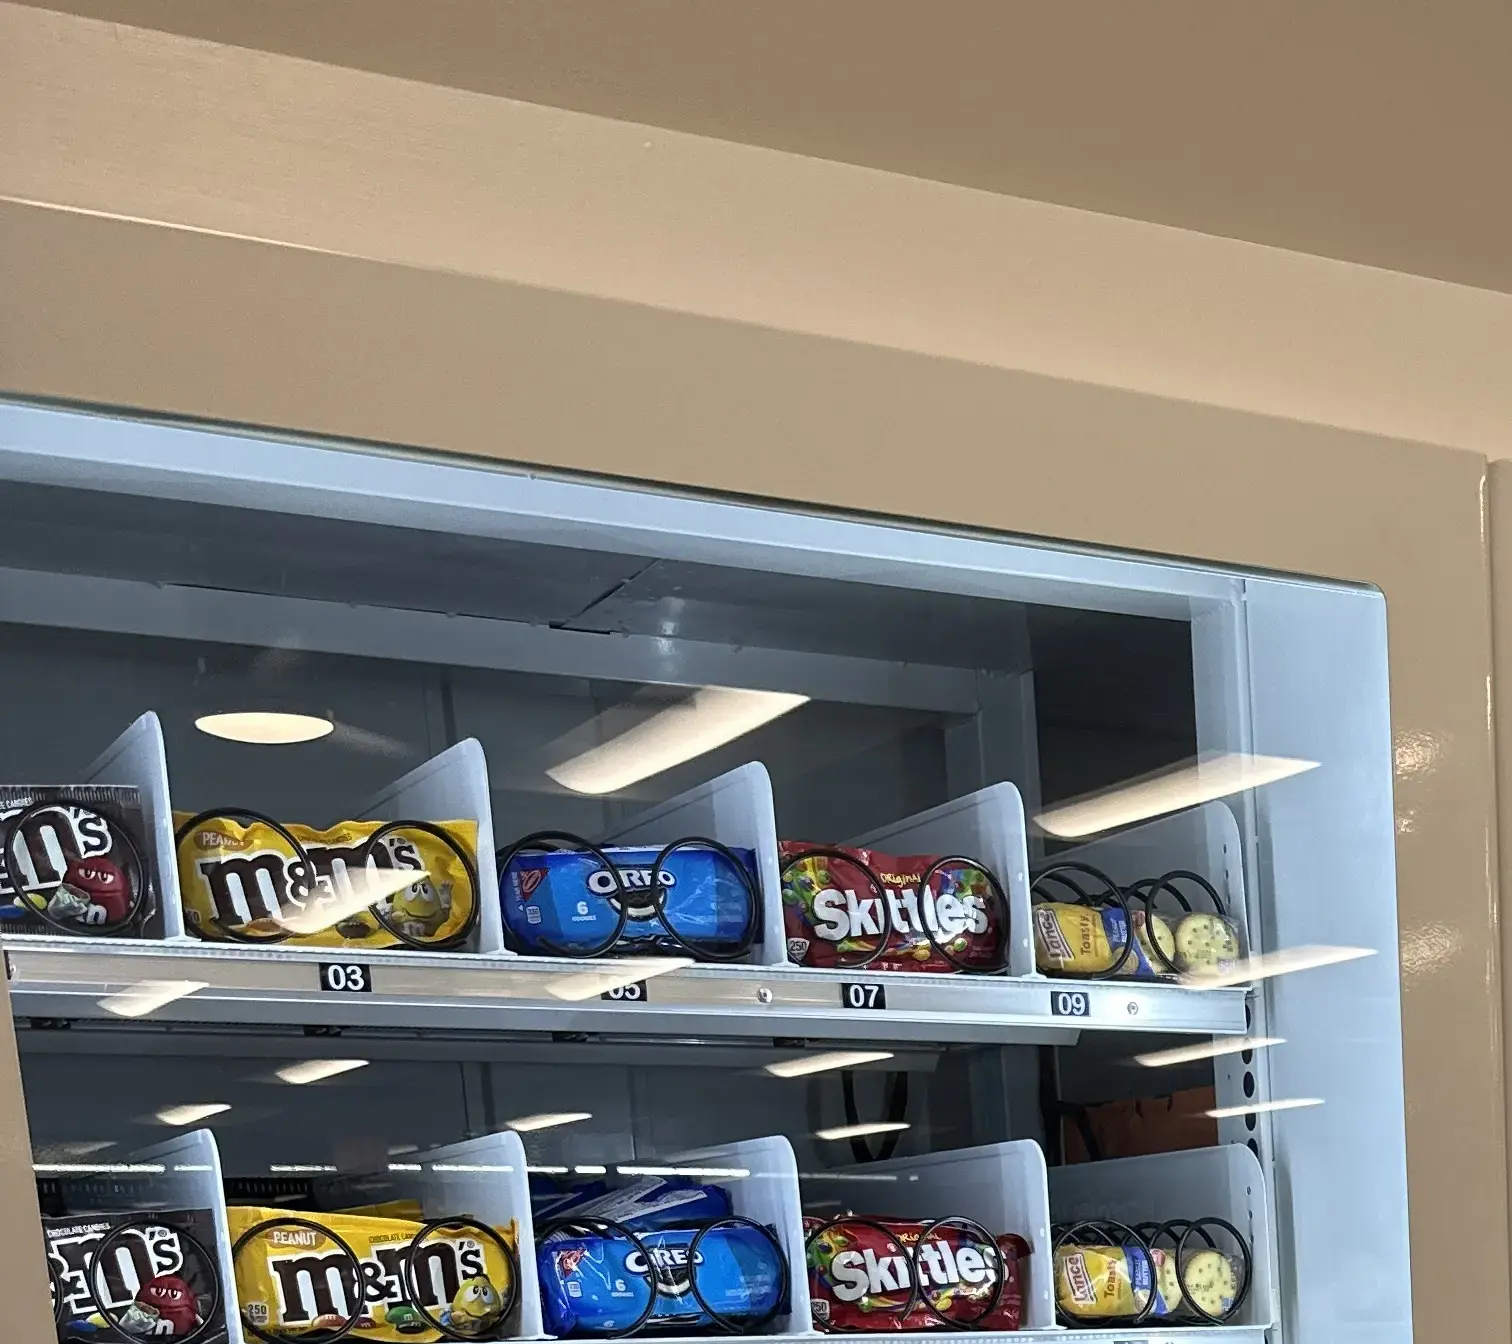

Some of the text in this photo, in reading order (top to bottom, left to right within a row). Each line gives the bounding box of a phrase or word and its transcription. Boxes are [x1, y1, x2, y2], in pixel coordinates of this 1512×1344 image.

[587, 868, 677, 896] OREO
[813, 885, 990, 941] Skittles
[327, 964, 366, 991] 03
[849, 983, 881, 1008] 07
[1057, 993, 1087, 1016] 09
[273, 1230, 317, 1247] PEANUT
[272, 1240, 488, 1323] m&m's
